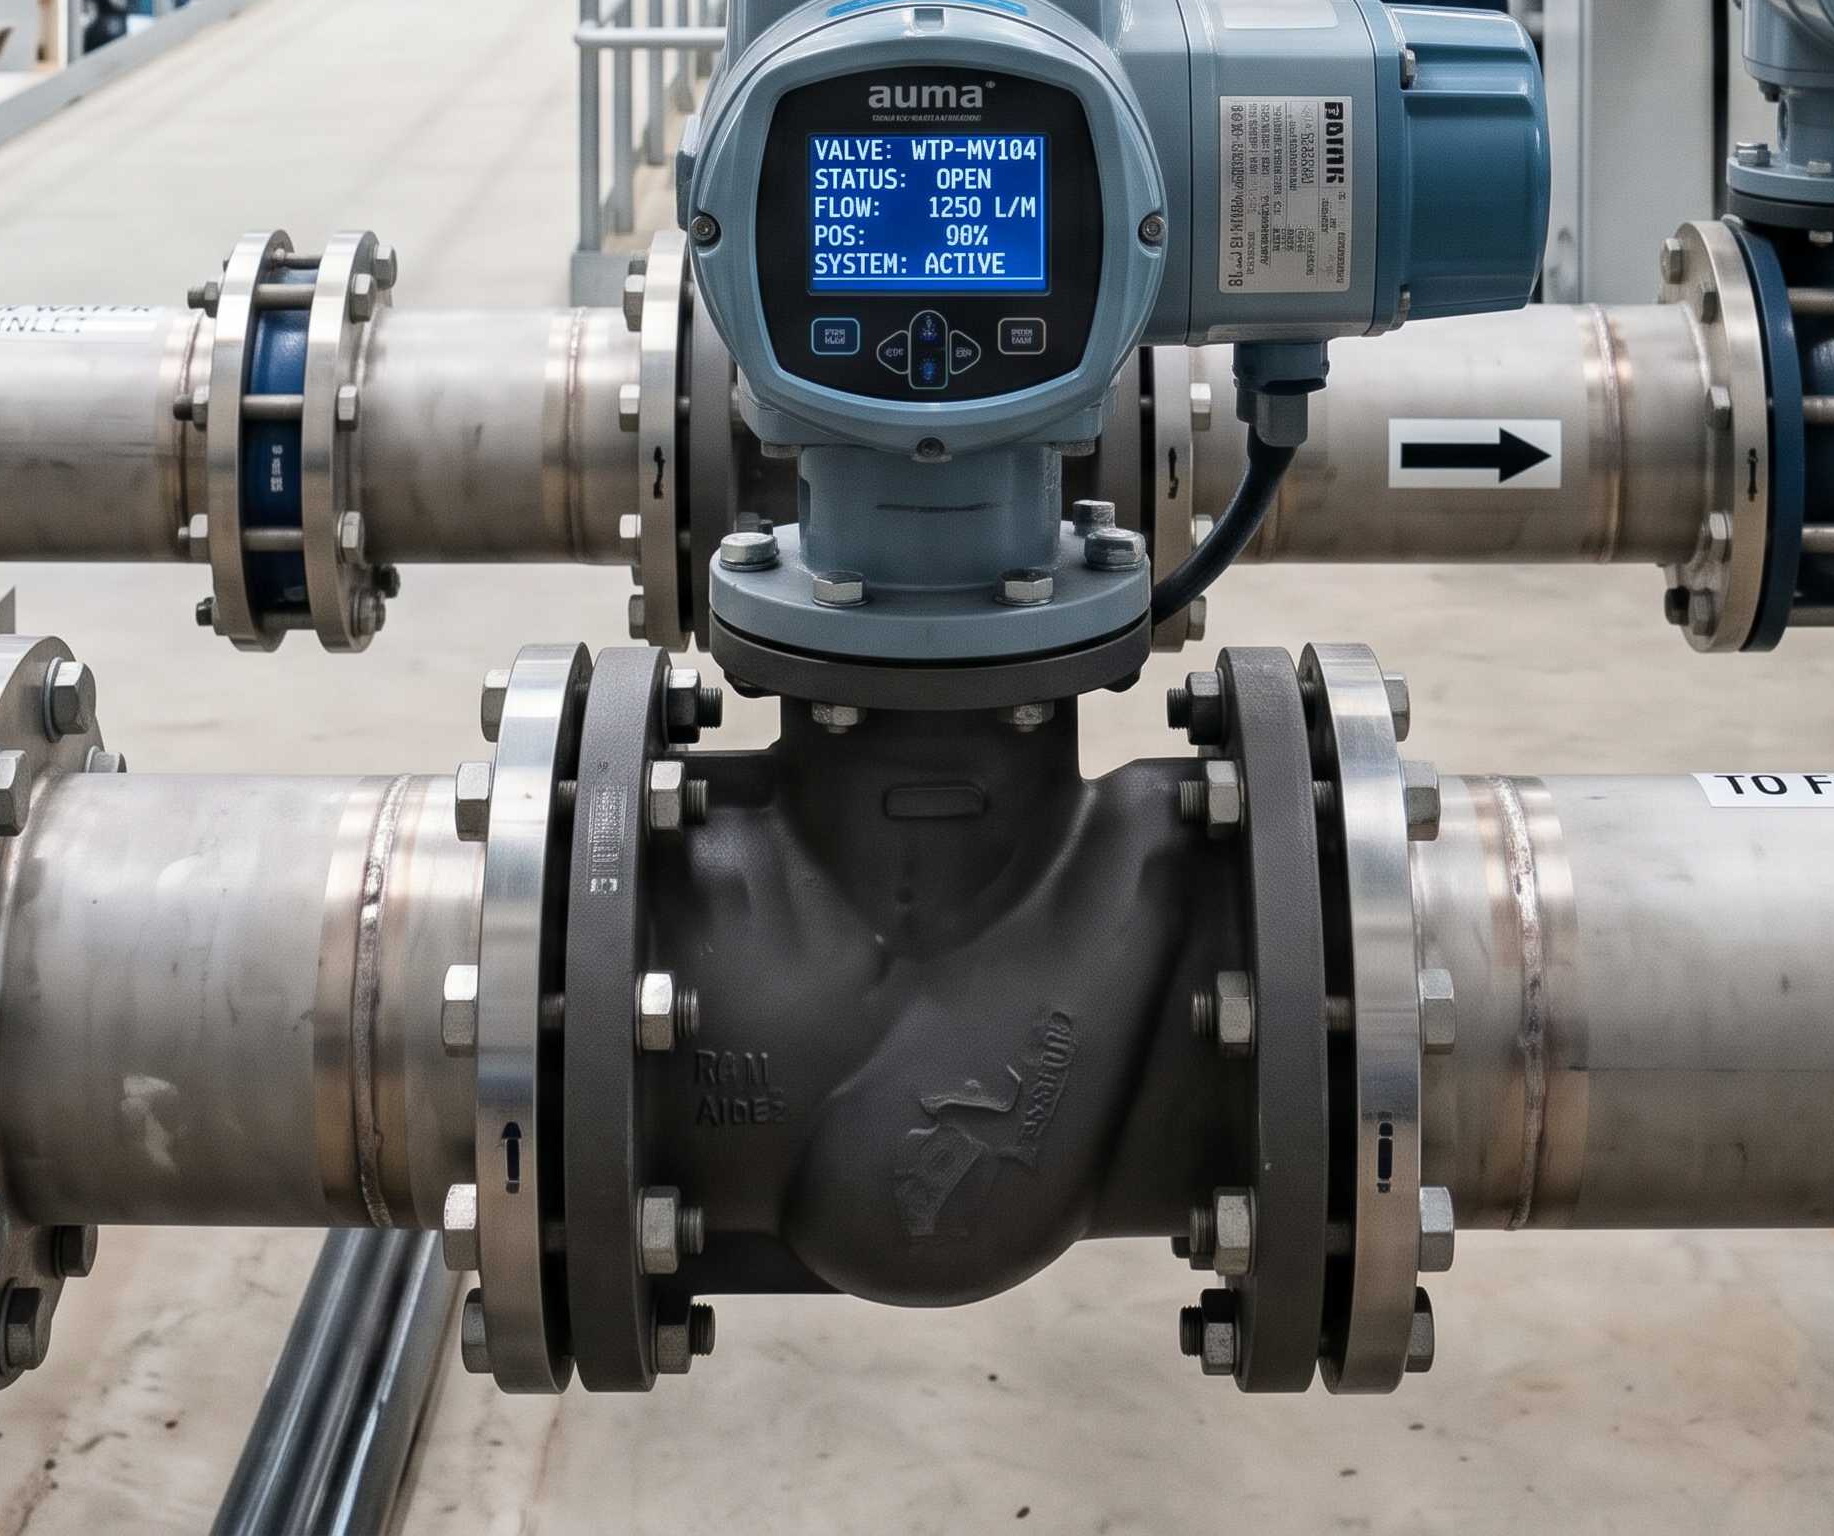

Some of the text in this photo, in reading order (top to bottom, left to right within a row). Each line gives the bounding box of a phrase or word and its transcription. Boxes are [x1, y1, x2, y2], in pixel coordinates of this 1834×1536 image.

[868, 85, 983, 109] auma
[815, 139, 1037, 161] VALVE: WTP-MV104
[815, 168, 992, 189] STATUS: OPEN
[815, 196, 1037, 218] FLOW: 1250 L/M
[815, 224, 865, 247] POS:
[815, 252, 1006, 275] SYSTEM: ACTIVE
[1713, 773, 1787, 796] TO
